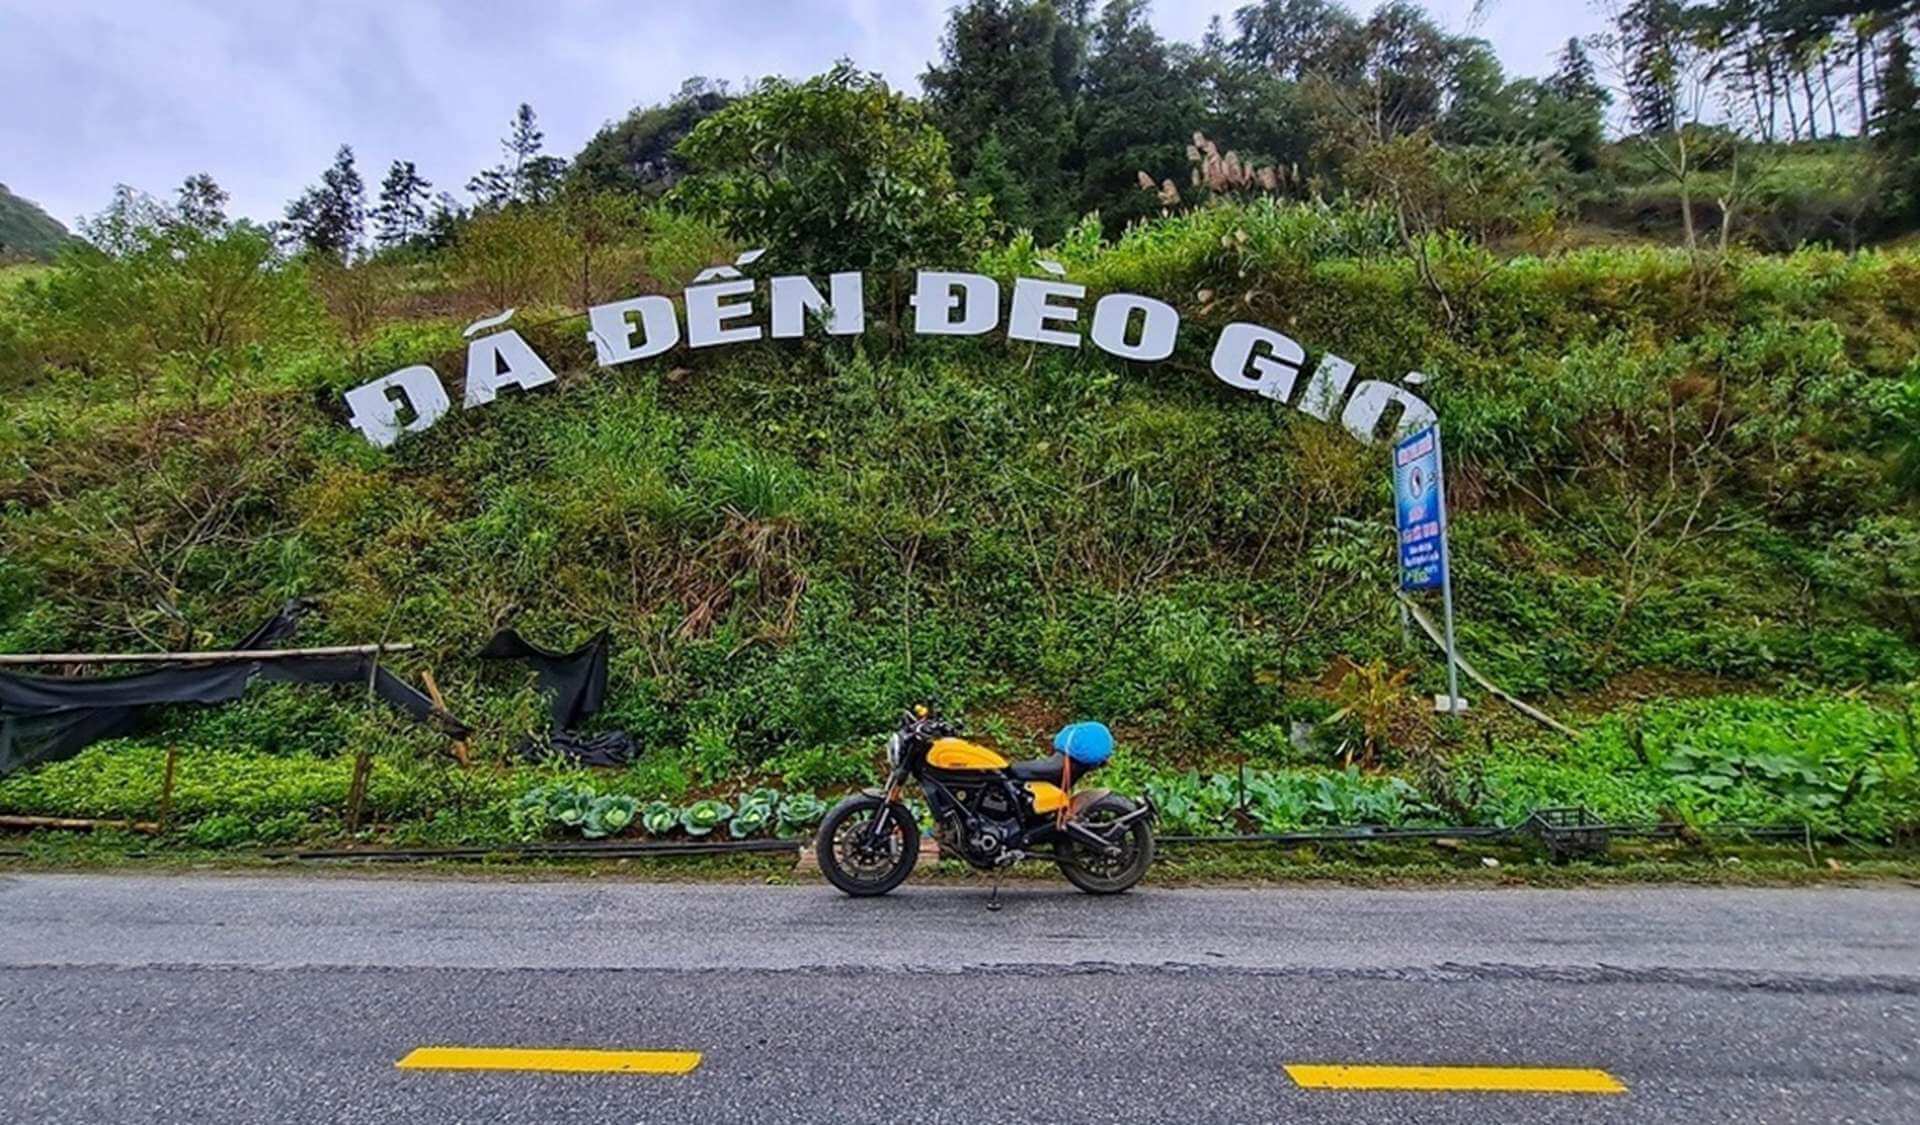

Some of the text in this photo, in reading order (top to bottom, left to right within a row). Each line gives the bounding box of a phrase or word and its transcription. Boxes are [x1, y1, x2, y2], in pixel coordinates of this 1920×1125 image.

[345, 248, 1438, 448] ĐÃ ĐẾN ĐÈO GIÓ
